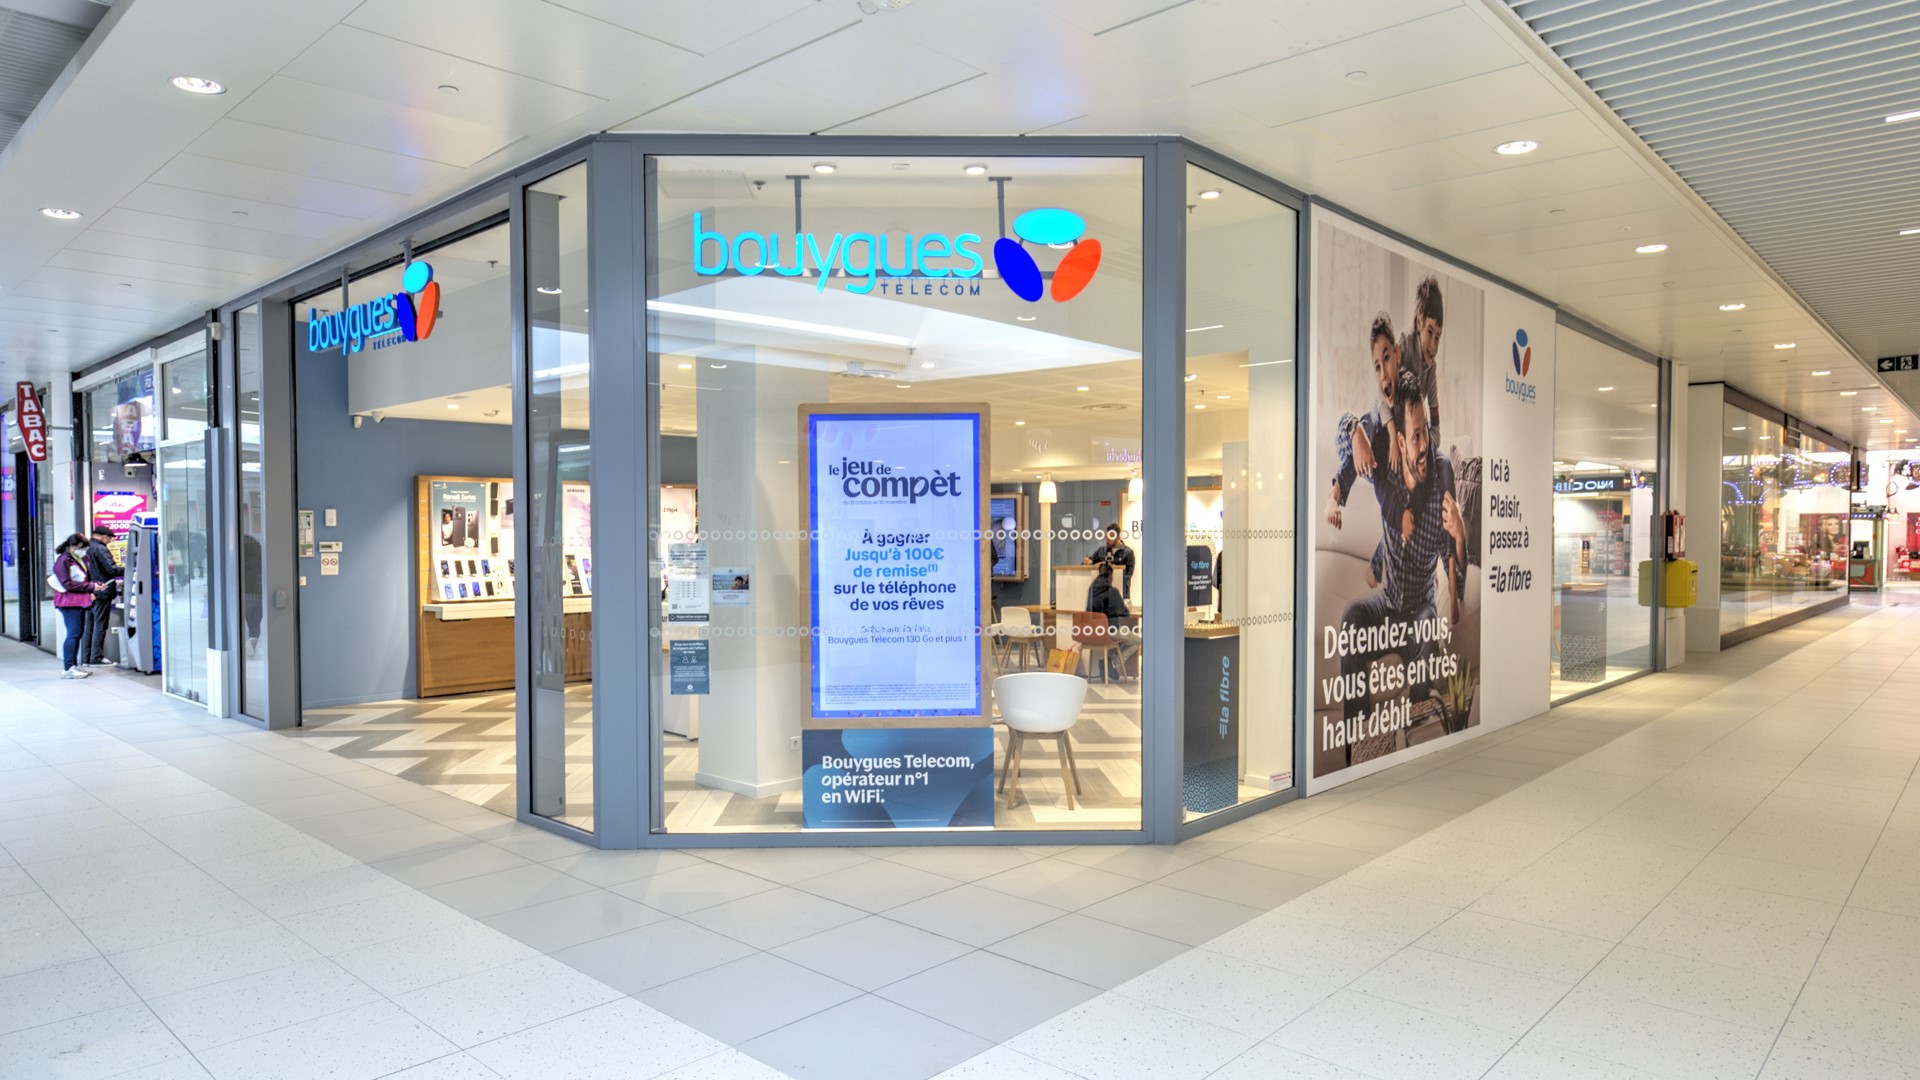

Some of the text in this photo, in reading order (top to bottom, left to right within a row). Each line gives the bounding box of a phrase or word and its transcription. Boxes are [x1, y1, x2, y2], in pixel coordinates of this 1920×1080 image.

[694, 211, 983, 294] bouygues
[880, 283, 981, 296] TELECOM
[309, 293, 398, 356] bouygues
[1505, 371, 1536, 401] bouygues
[20, 384, 46, 457] TABAC
[829, 456, 892, 480] le jeu de
[1490, 458, 1510, 482] Ici à
[843, 469, 962, 504] compèt
[1490, 494, 1522, 522] Plaisir,
[862, 528, 930, 547] À gagner
[1489, 526, 1529, 554] passez à
[845, 547, 944, 563] Jusqu'à 100€
[853, 564, 872, 577] de
[1496, 564, 1532, 592] la fibre
[833, 580, 957, 596] sur le téléphone
[850, 597, 944, 611] de vos rêves
[828, 636, 869, 646] Bouygues
[870, 635, 905, 643] Telecom
[906, 635, 921, 643] 130
[922, 635, 934, 643] Go
[945, 634, 963, 644] plus
[1323, 616, 1452, 659] Détendez-vous,
[1322, 647, 1457, 705] vous êtes en très
[1220, 655, 1230, 724] la fibre
[1322, 696, 1413, 751] haut débit
[822, 754, 975, 772] Bouygues Telecom,
[821, 772, 929, 789] opérateur n°1
[821, 792, 842, 803] en
